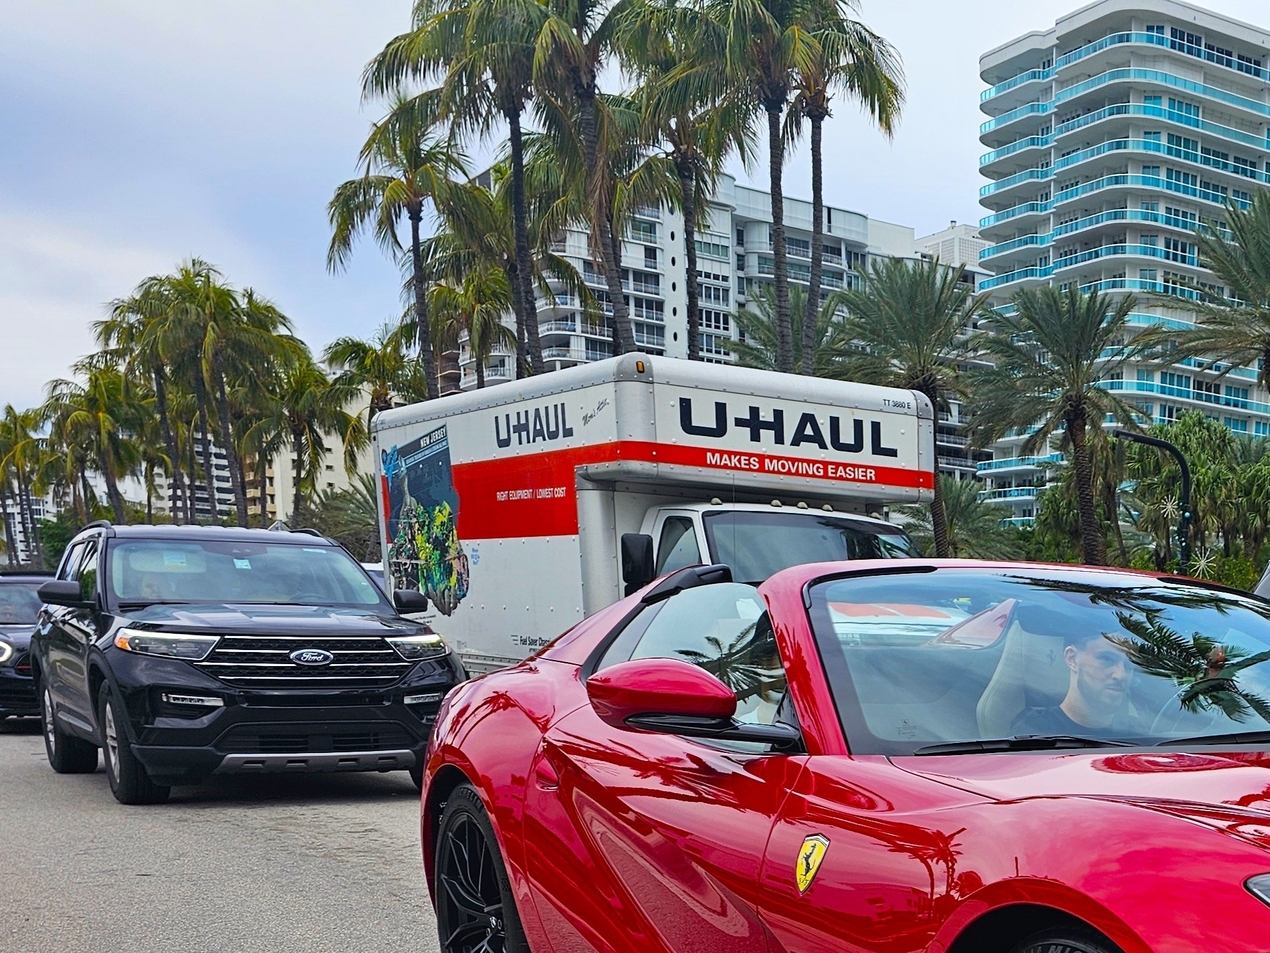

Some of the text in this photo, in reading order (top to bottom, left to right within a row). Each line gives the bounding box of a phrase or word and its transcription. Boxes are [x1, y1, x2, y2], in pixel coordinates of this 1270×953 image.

[420, 426, 446, 448] NEW JERSEY
[494, 402, 574, 448] U-HAUL
[679, 397, 898, 457] U-HAUL
[706, 451, 876, 481] MAKES MOVING EASIER
[509, 488, 533, 500] EQUIPMENT
[536, 488, 554, 499] LOWEST
[554, 486, 567, 498] COST
[301, 652, 324, 661] Ford
